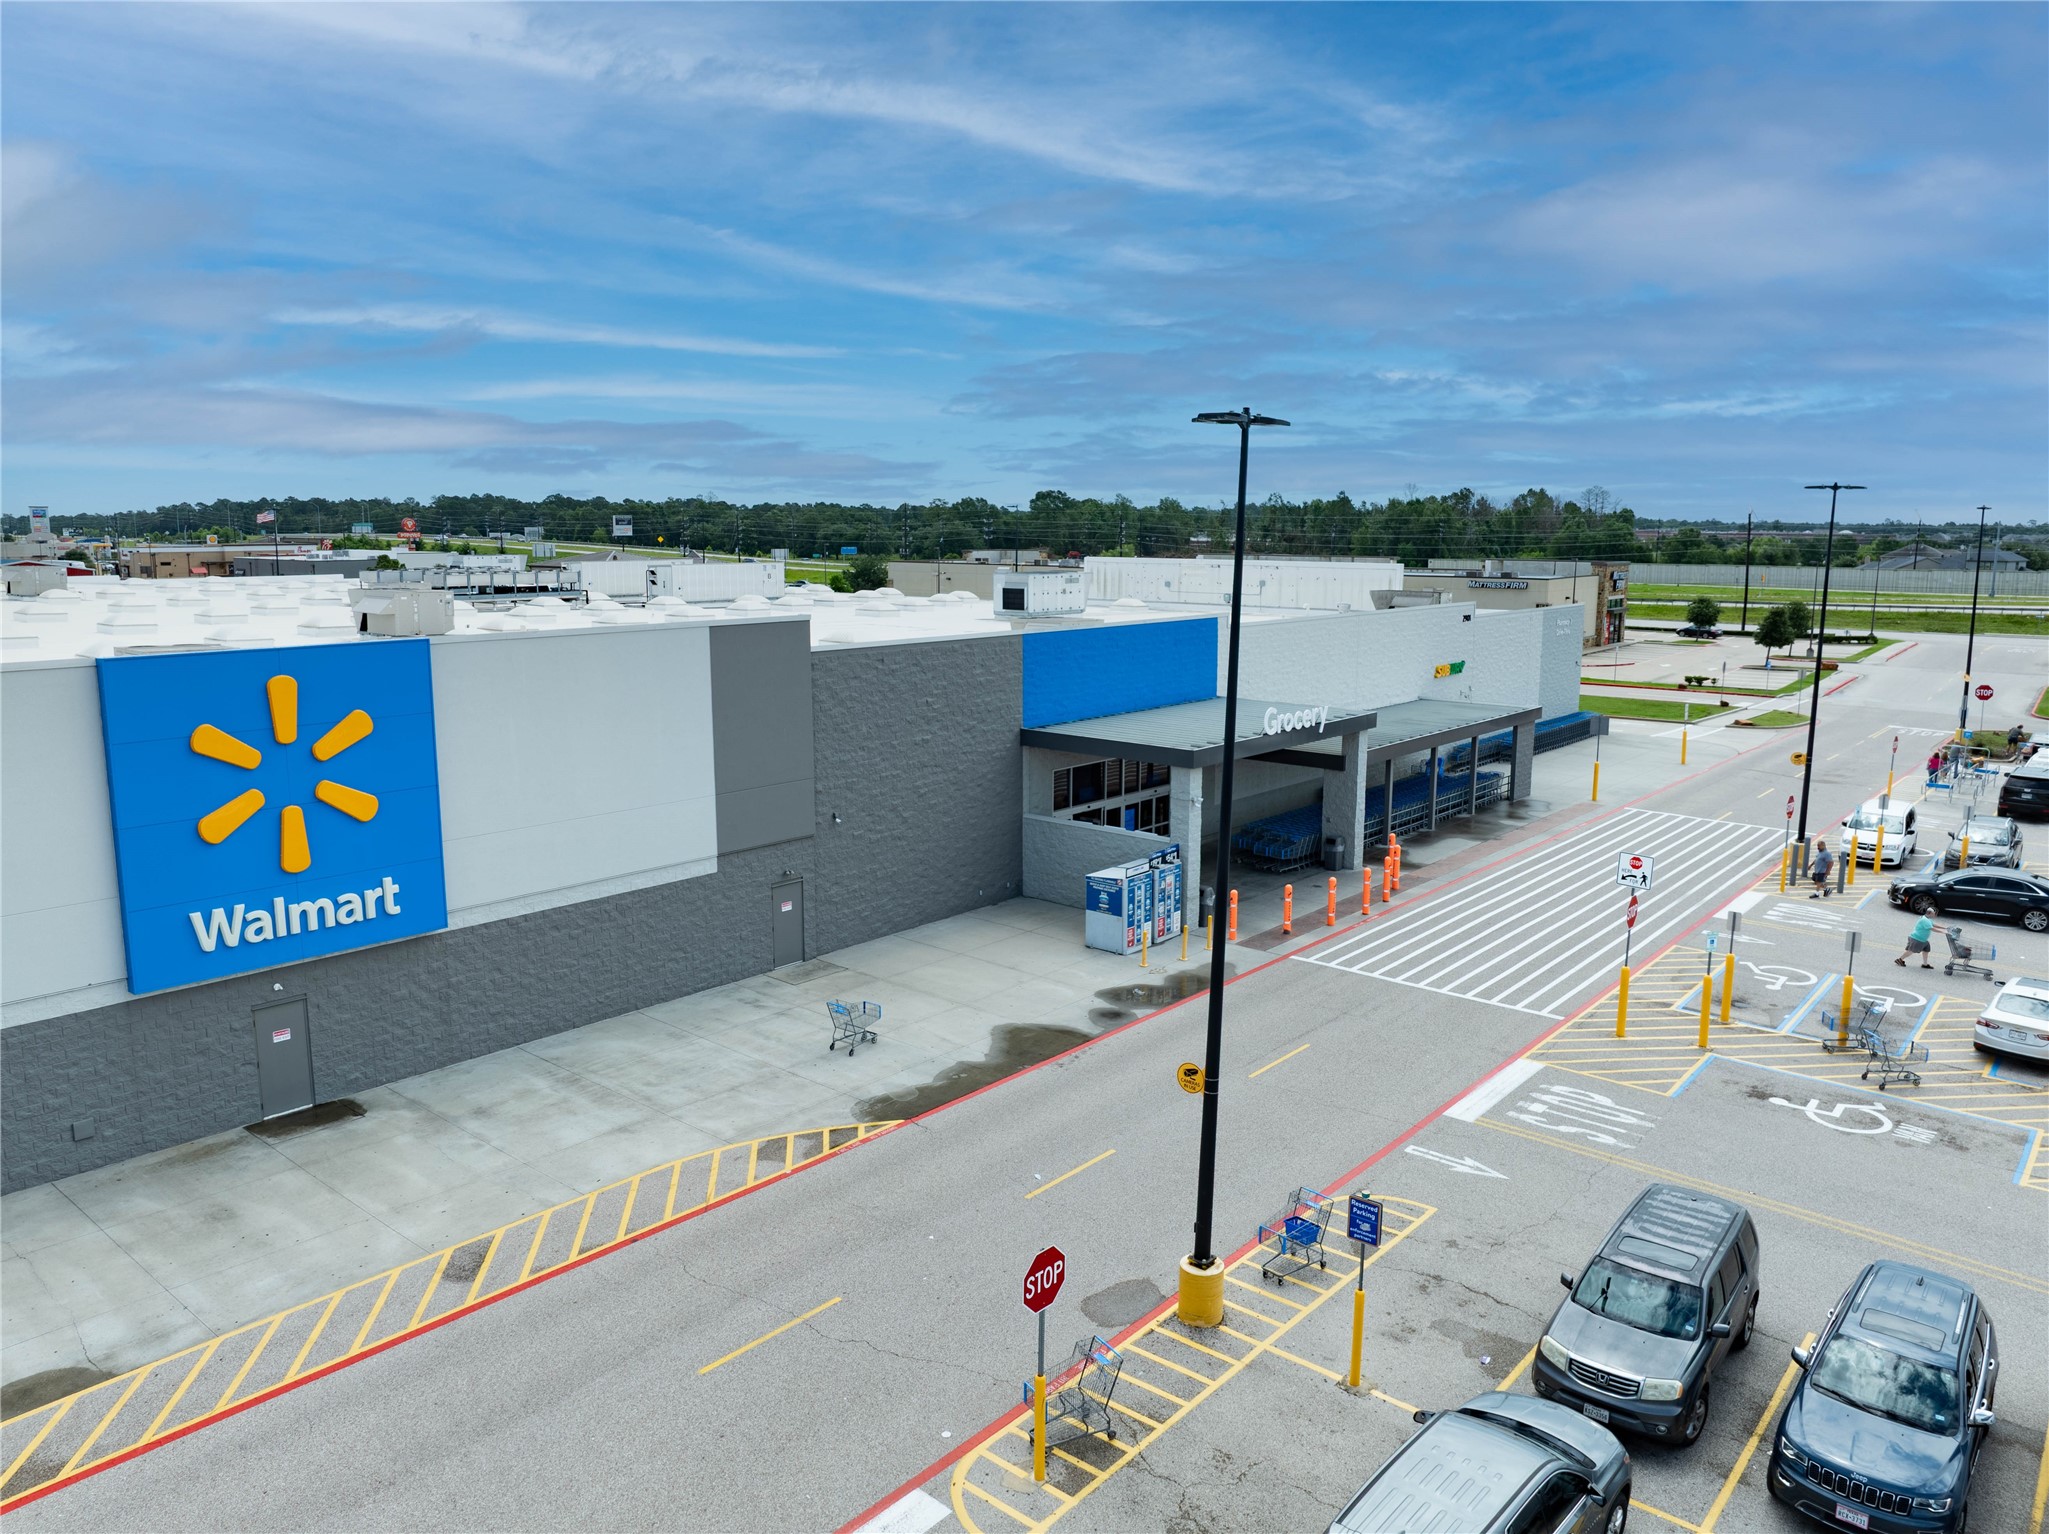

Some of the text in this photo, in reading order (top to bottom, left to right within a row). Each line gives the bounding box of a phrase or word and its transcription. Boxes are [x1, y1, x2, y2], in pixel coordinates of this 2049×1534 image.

[1264, 705, 1329, 735] Grocery
[1630, 859, 1643, 867] STOP
[188, 876, 402, 952] Walmart
[1627, 904, 1638, 921] STOP
[1181, 1077, 1201, 1088] CAMERAS
[1351, 1199, 1378, 1213] Reserved
[1352, 1206, 1376, 1221] Parking
[1025, 1259, 1064, 1300] STOP
[1850, 1472, 1868, 1483] Jeep
